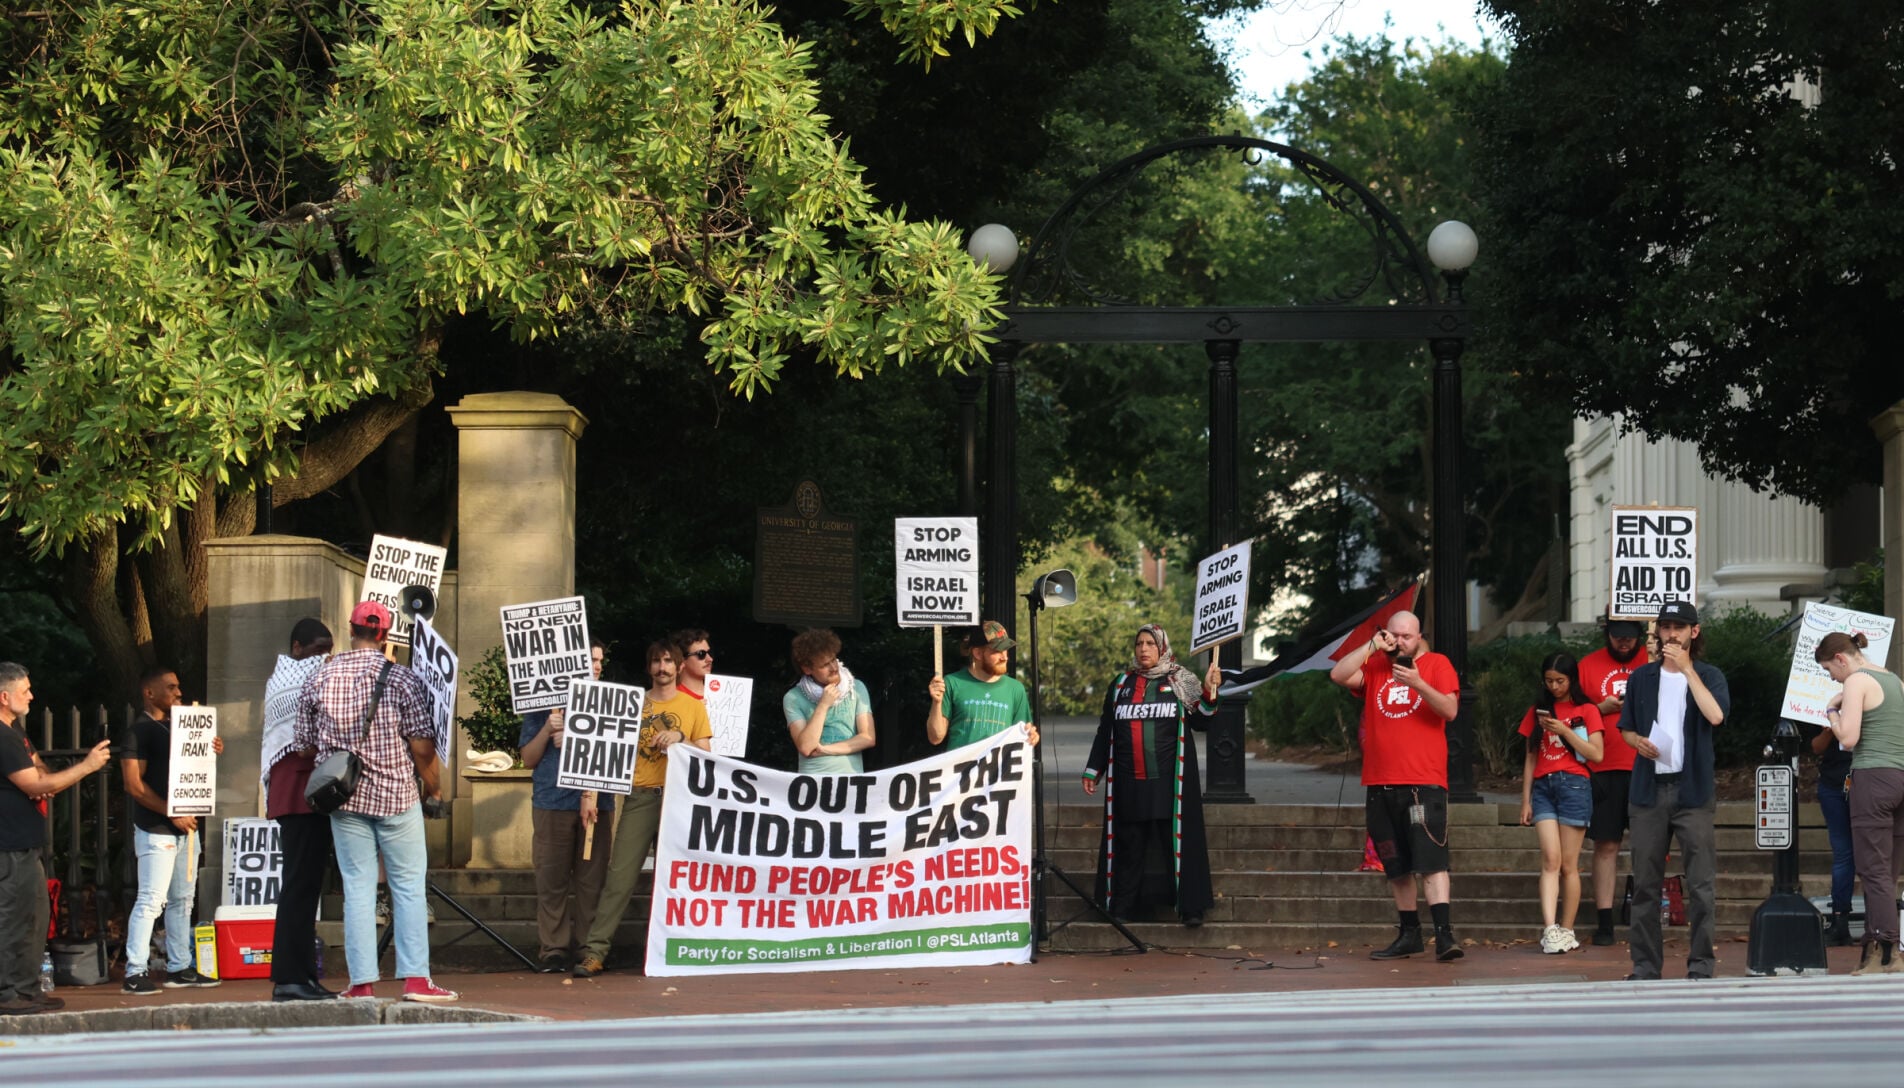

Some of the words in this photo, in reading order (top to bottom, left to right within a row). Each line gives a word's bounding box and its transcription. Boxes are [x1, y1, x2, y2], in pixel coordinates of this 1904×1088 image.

[761, 516, 805, 528] UNIVERSITY
[809, 520, 818, 529] OF
[821, 520, 854, 531] GEORGIA
[1617, 515, 1693, 536] END
[914, 527, 962, 542] STOP
[374, 544, 411, 565] STOP
[414, 552, 440, 572] THE
[904, 548, 972, 562] ARMING
[1616, 538, 1650, 558] ALL
[1656, 538, 1692, 559] U.S.
[1207, 554, 1238, 577] STOP
[908, 577, 968, 592] ISRAEL
[1200, 570, 1242, 598] ARMING
[1616, 566, 1656, 591] AID
[1662, 566, 1691, 592] TO
[912, 595, 963, 610] NOW!
[1200, 594, 1238, 620] ISRAEL
[506, 608, 530, 620] TRUMP
[531, 608, 538, 617] &
[506, 620, 534, 632] NO
[538, 613, 582, 628] NEW
[1200, 610, 1234, 634] NOW!
[415, 620, 454, 684] NO
[506, 628, 558, 659] WAR
[562, 624, 586, 652] IN
[510, 661, 534, 680] THE
[538, 654, 589, 676] MIDDLE
[724, 680, 744, 697] NO
[1387, 686, 1411, 705] PSL
[572, 683, 640, 718] HANDS
[708, 696, 744, 711] WAR
[1115, 702, 1177, 720] PALESTINE
[178, 714, 212, 729] HANDS
[568, 714, 638, 739] OFF
[188, 731, 202, 740] OFF
[181, 742, 208, 757] IRAN!
[562, 736, 635, 780] IRAN!
[180, 773, 194, 784] END
[194, 773, 208, 784] THE
[687, 755, 770, 806] U.S.
[788, 776, 876, 814] OUT
[888, 768, 942, 812] OF
[954, 742, 1024, 794] THE
[174, 788, 212, 798] GENOCIDE!
[688, 804, 886, 859] MIDDLE
[903, 790, 1017, 852] EAST
[240, 826, 282, 852] HAN
[239, 853, 284, 872] OF
[669, 860, 756, 894] FUND
[768, 860, 914, 896] PEOPLE'S
[924, 845, 1030, 881] NEEDS,
[666, 897, 728, 926] NOT
[737, 898, 796, 928] THE
[806, 897, 878, 928] WAR
[888, 881, 1030, 920] MACHINE!
[678, 946, 718, 962] Party
[721, 945, 743, 960] for
[748, 944, 821, 960] Socialism
[826, 942, 836, 955] &
[840, 936, 912, 954] Liberation
[926, 930, 1019, 948] @PSLAtlanta
